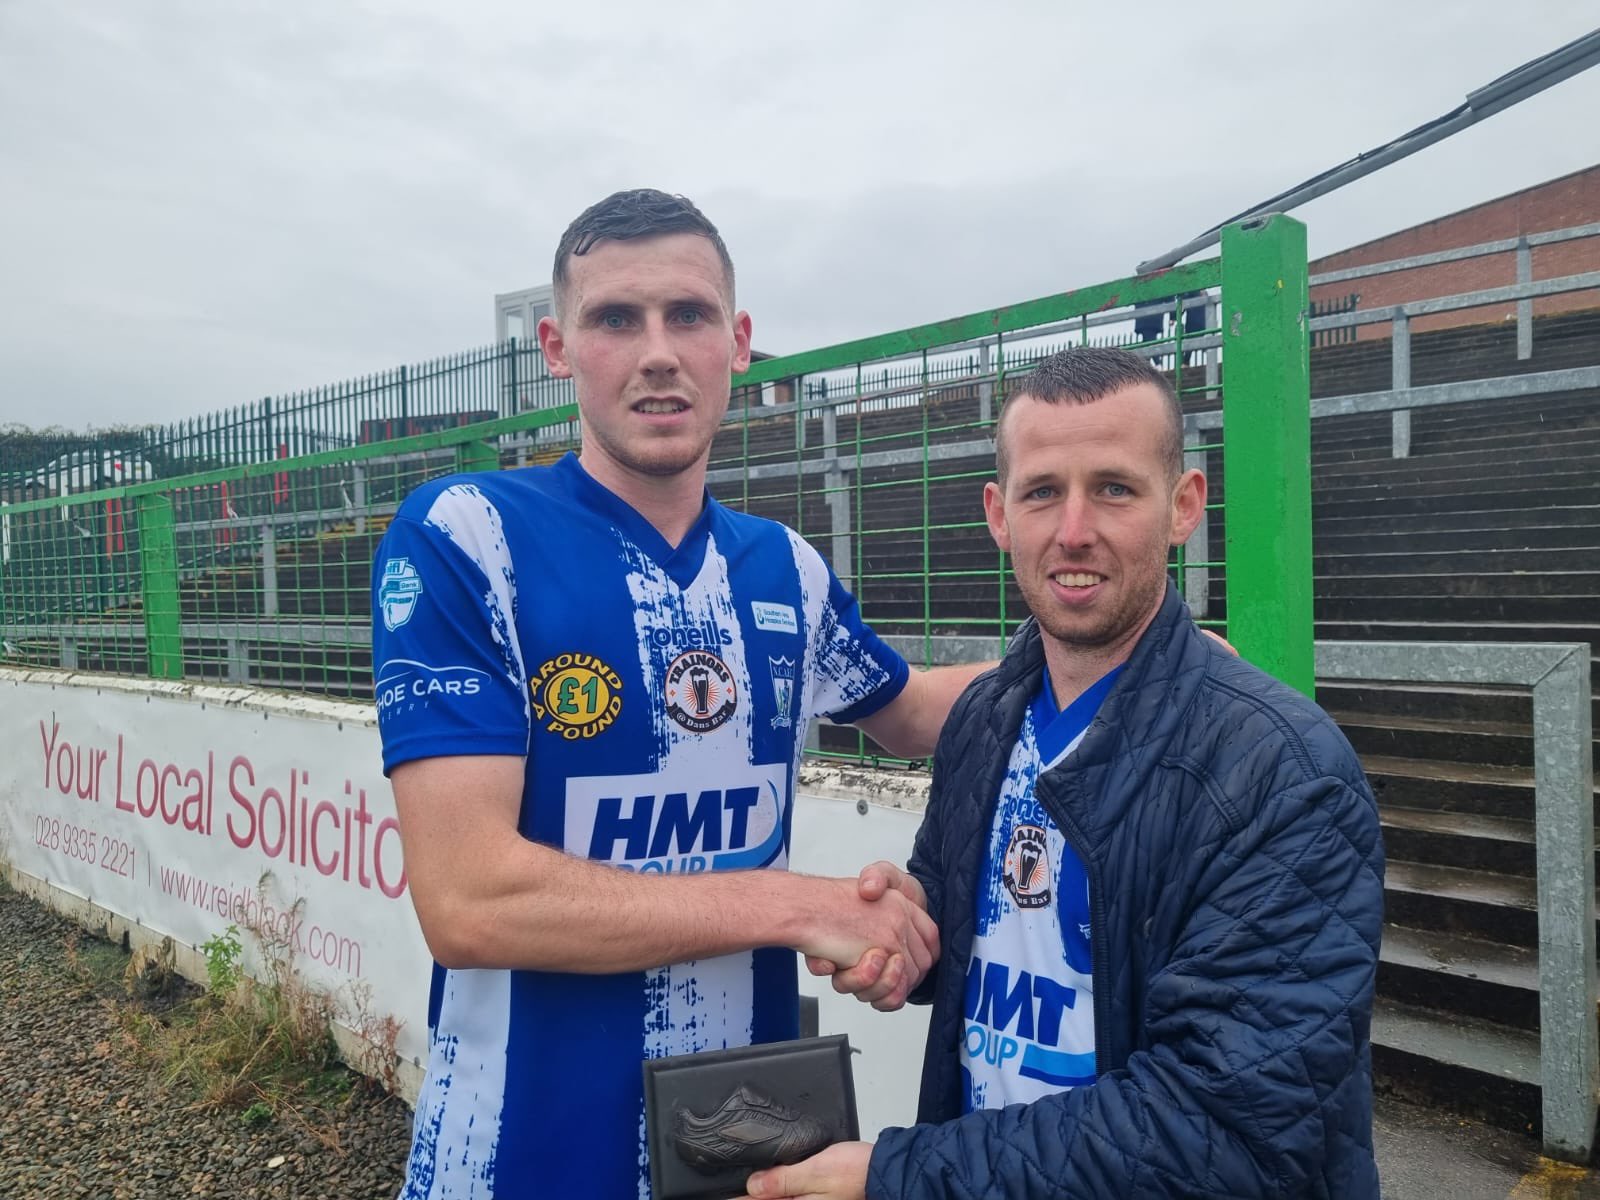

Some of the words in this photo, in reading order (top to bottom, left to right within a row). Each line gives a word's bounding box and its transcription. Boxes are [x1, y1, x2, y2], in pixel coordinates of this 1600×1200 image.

[653, 620, 733, 647] oneills
[530, 653, 623, 697] AROUND
[669, 654, 730, 685] TRAINORS
[376, 683, 406, 714] HOE
[412, 678, 481, 696] CARS
[557, 676, 599, 715] £1
[532, 702, 546, 721] A
[547, 696, 622, 740] POUND
[686, 718, 710, 729] Dans
[711, 710, 727, 724] Bar
[39, 719, 108, 802] Your
[115, 733, 214, 836] Local
[226, 755, 409, 900] Solicito
[588, 786, 760, 861] HMT
[617, 856, 706, 876] OUP
[35, 815, 60, 851] 028
[62, 823, 97, 865] 9335
[101, 835, 135, 881] 2221
[160, 865, 361, 978] www.reidblack.com
[964, 1025, 1019, 1070] OUP
